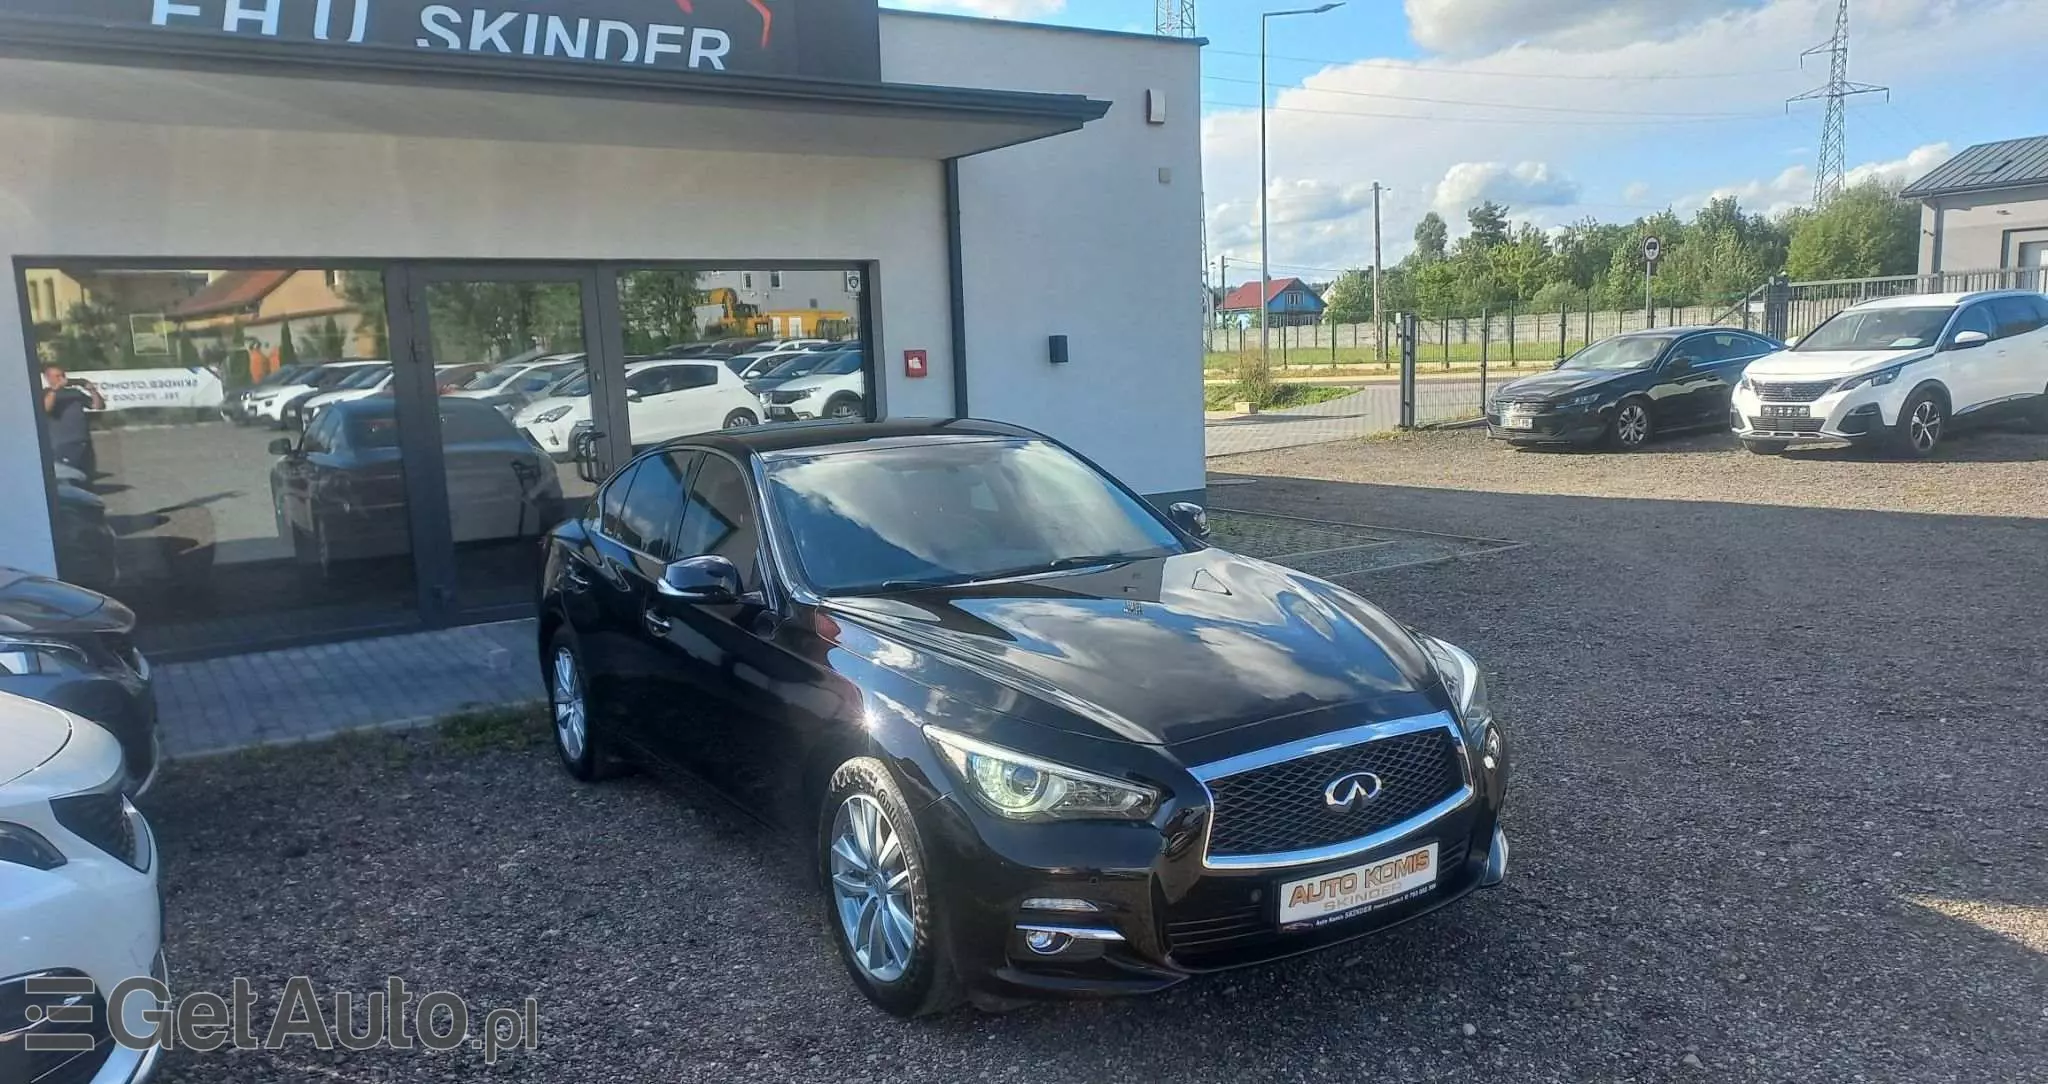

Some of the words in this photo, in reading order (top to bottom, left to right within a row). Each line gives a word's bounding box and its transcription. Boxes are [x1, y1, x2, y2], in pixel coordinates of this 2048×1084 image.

[415, 4, 731, 70] SKINDER
[1288, 873, 1358, 908] AUTO
[1364, 849, 1430, 889] KOMIS
[1323, 881, 1402, 911] SKINDER
